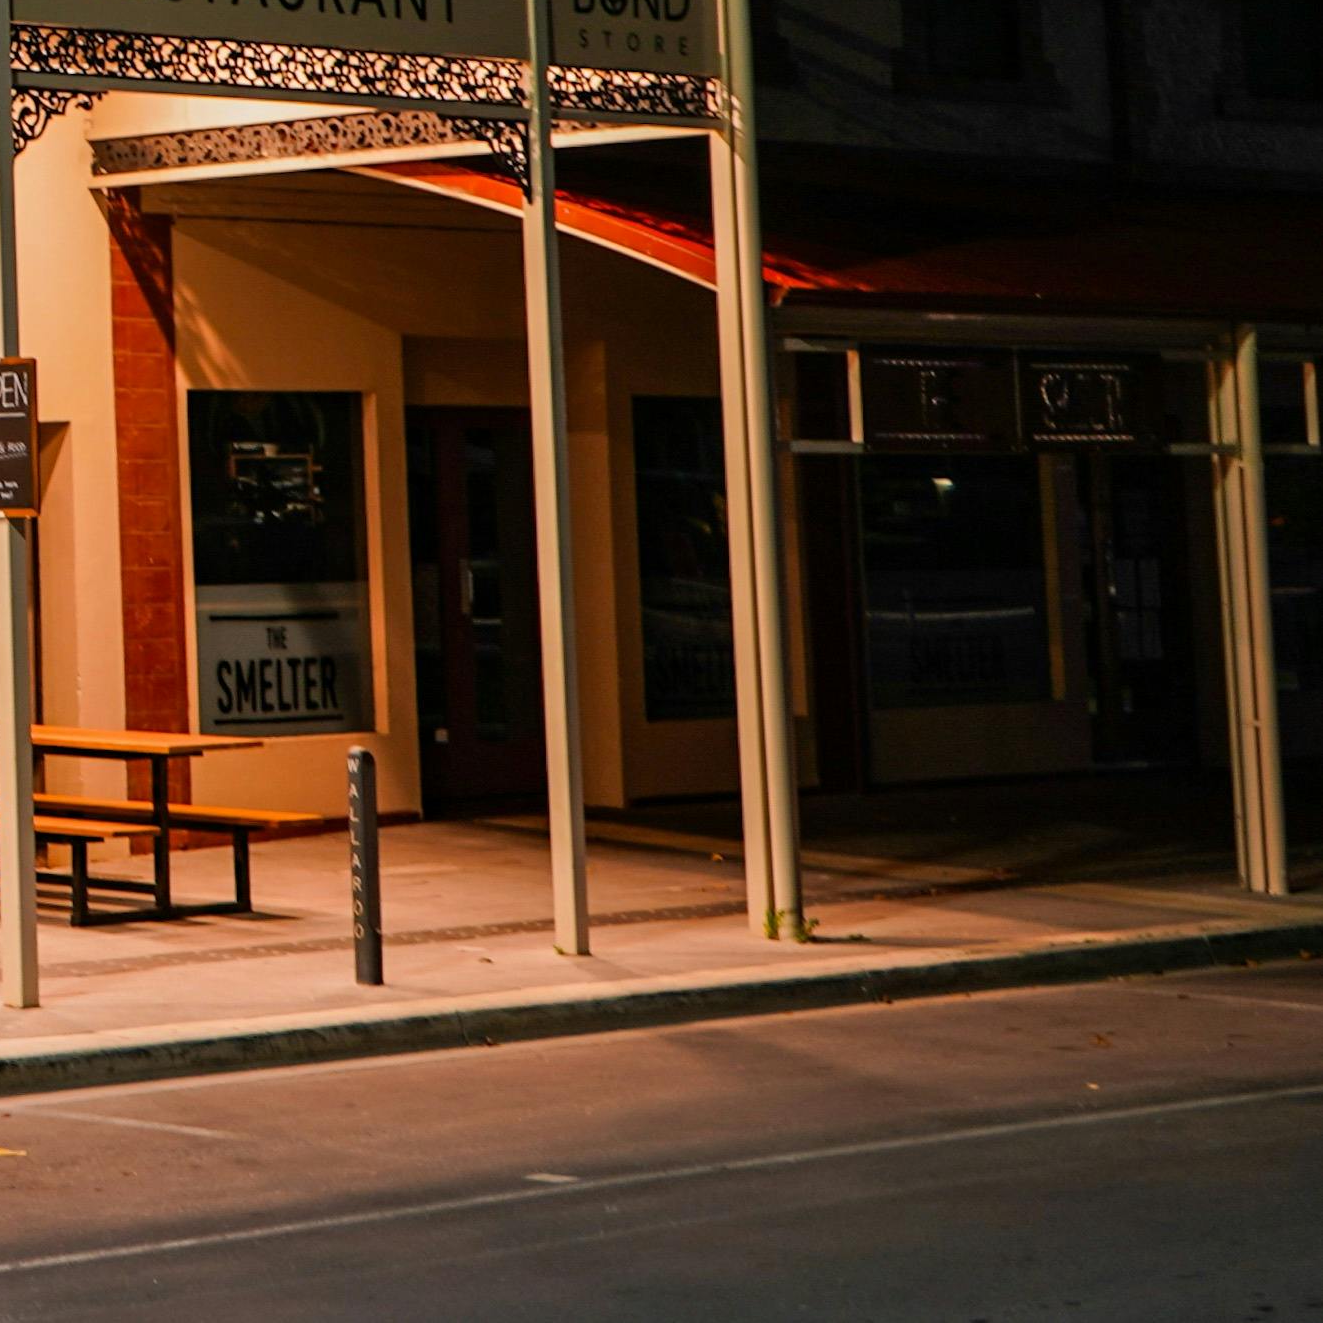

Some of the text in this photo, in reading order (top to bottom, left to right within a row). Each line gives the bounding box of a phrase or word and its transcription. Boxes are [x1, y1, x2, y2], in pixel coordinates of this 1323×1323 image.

[578, 27, 689, 57] STORE
[265, 626, 288, 650] THE
[216, 656, 340, 714] SMELTER
[347, 757, 365, 940] WALLAROO
